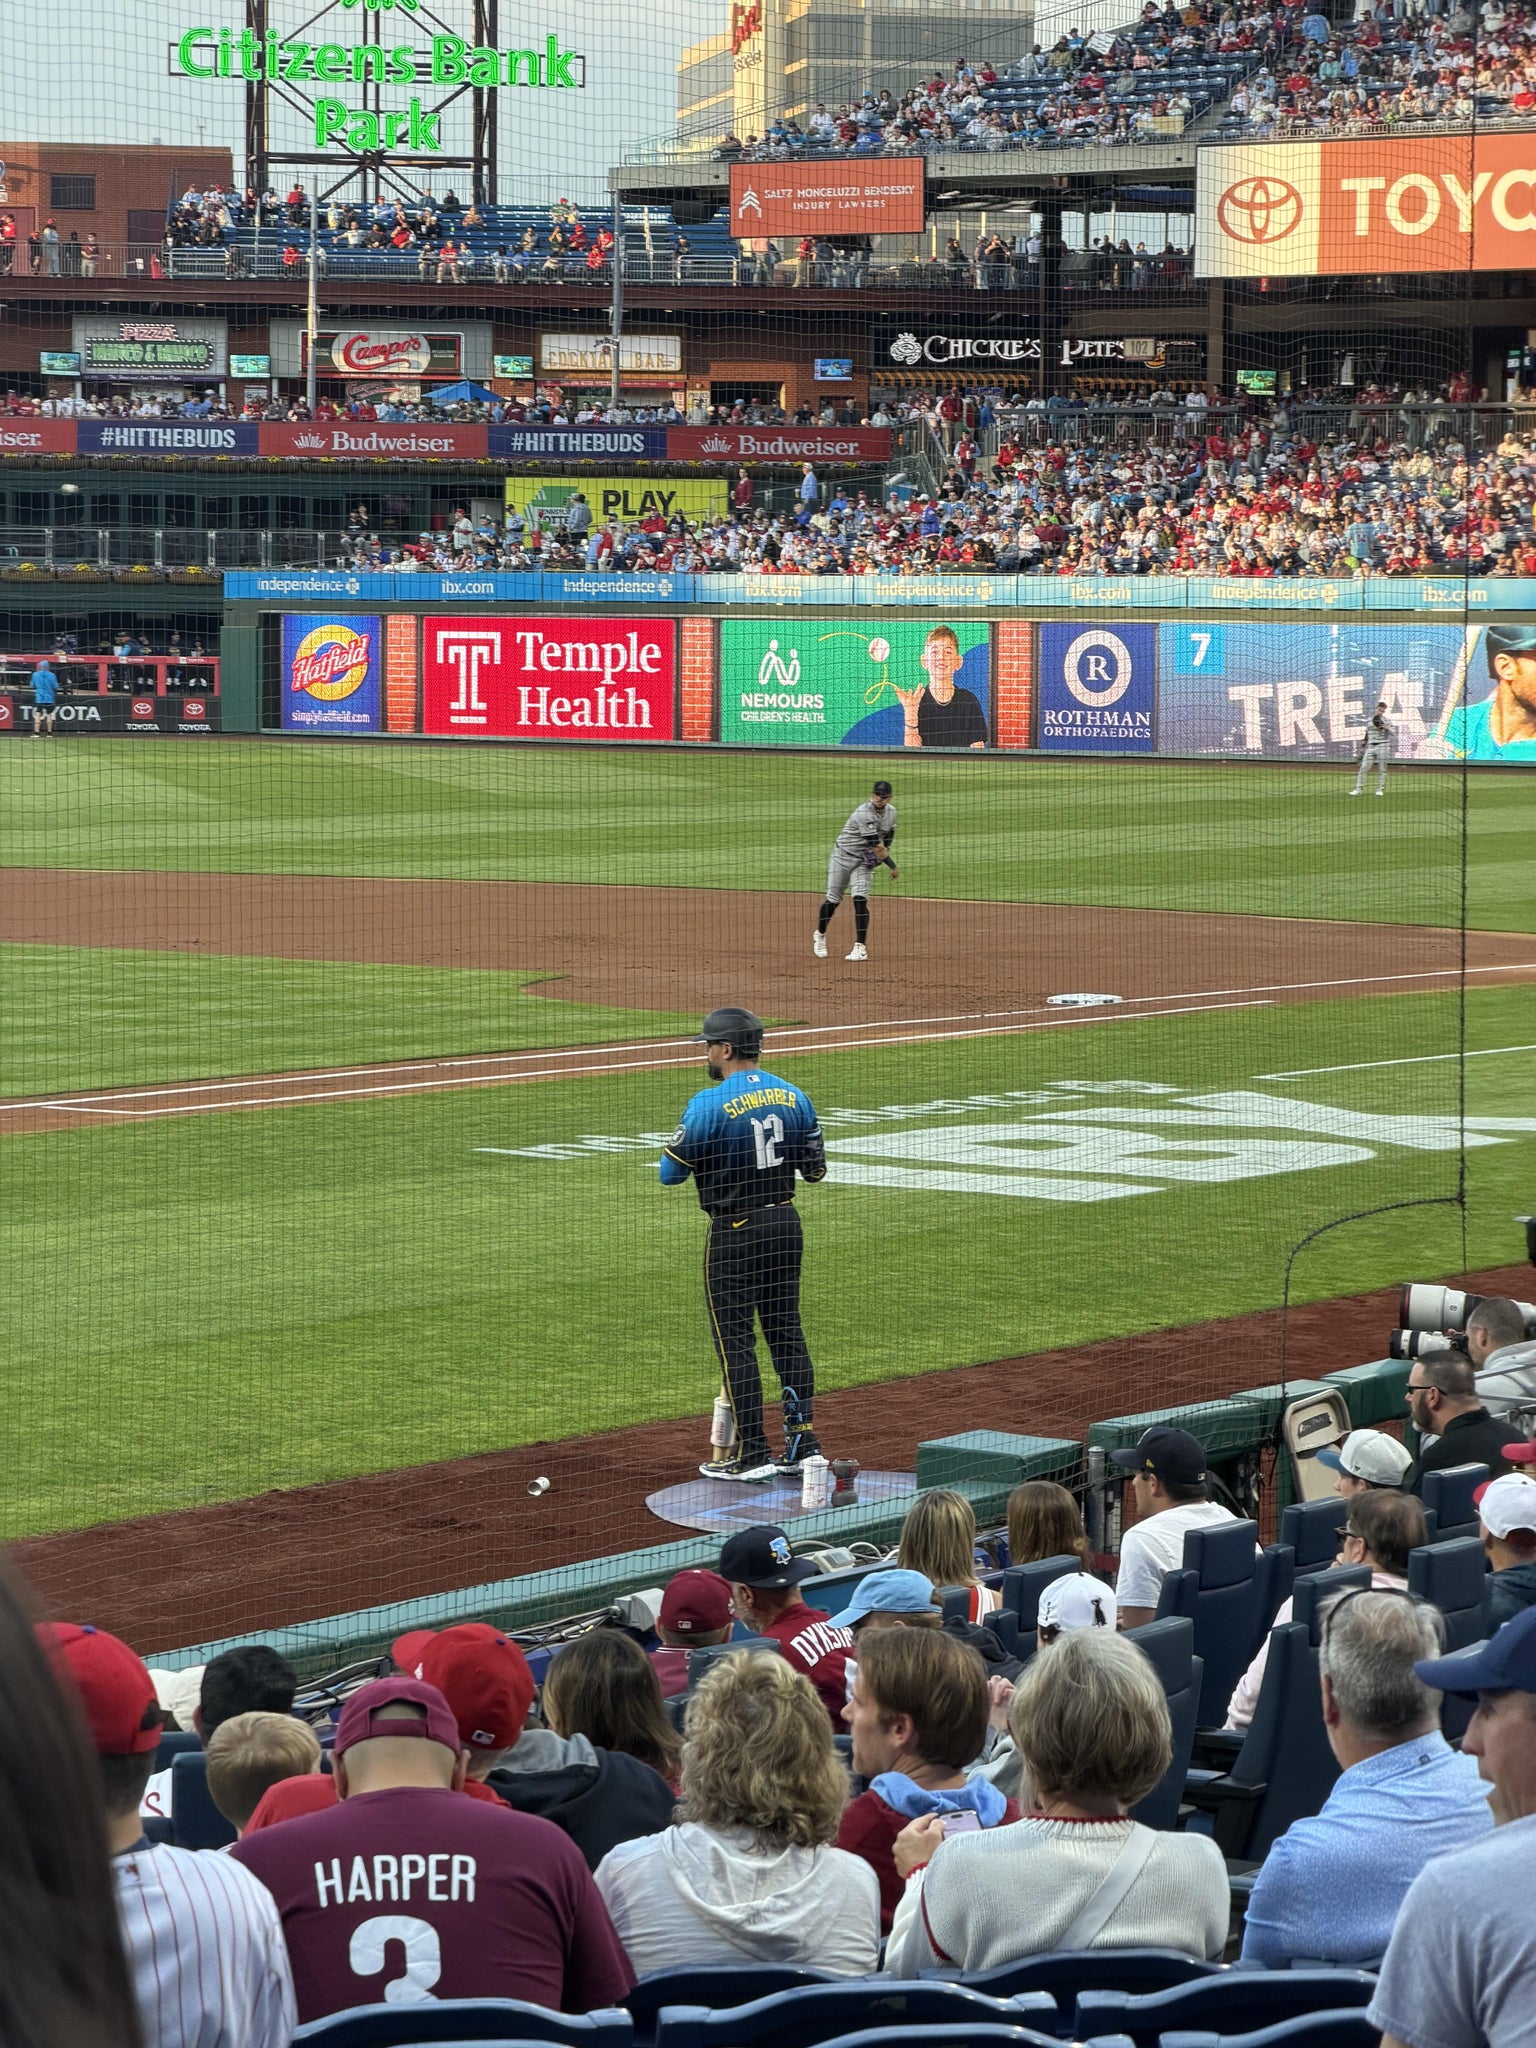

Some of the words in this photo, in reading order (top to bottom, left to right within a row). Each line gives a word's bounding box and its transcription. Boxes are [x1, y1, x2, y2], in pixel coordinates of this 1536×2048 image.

[178, 27, 416, 84] Citizens
[432, 34, 578, 89] Bank
[315, 98, 442, 152] Park
[764, 188, 793, 199] SALTZ
[797, 186, 861, 198] MONCELUZZI
[864, 185, 916, 196] BENDESKY
[793, 201, 831, 211] INJURY
[839, 200, 887, 209] LAWYERS
[124, 326, 175, 341] PIZZA
[342, 333, 422, 371] Campo's
[924, 335, 1041, 363] CHICKIE'S
[1131, 341, 1148, 356] 102
[547, 350, 613, 370] COCKTA
[634, 352, 665, 368] BAR
[100, 427, 236, 449] #HITTHEBUDS
[511, 432, 645, 454] #HITTHEBUDS
[603, 489, 677, 517] PLAY
[441, 579, 494, 595] ibx.com
[745, 581, 802, 598] ibx.com
[1071, 583, 1132, 600] ibx.com
[1422, 586, 1488, 602] ibx.com
[516, 632, 662, 685] Temple
[1190, 632, 1212, 667] 7
[292, 634, 370, 691] Hatfield
[1086, 655, 1112, 681] R
[516, 686, 654, 729] Health
[741, 692, 825, 709] NEMOURS
[741, 710, 790, 722] CHILDREN'S
[1044, 709, 1151, 726] ROTHMAN
[125, 723, 160, 731] TOYOTA
[177, 723, 212, 731] TOYOTA
[1044, 726, 1151, 739] ORTHOPAEDICS
[723, 1087, 797, 1119] SCHWARBER
[750, 1113, 785, 1170] 12
[314, 1853, 477, 1908] HARPER
